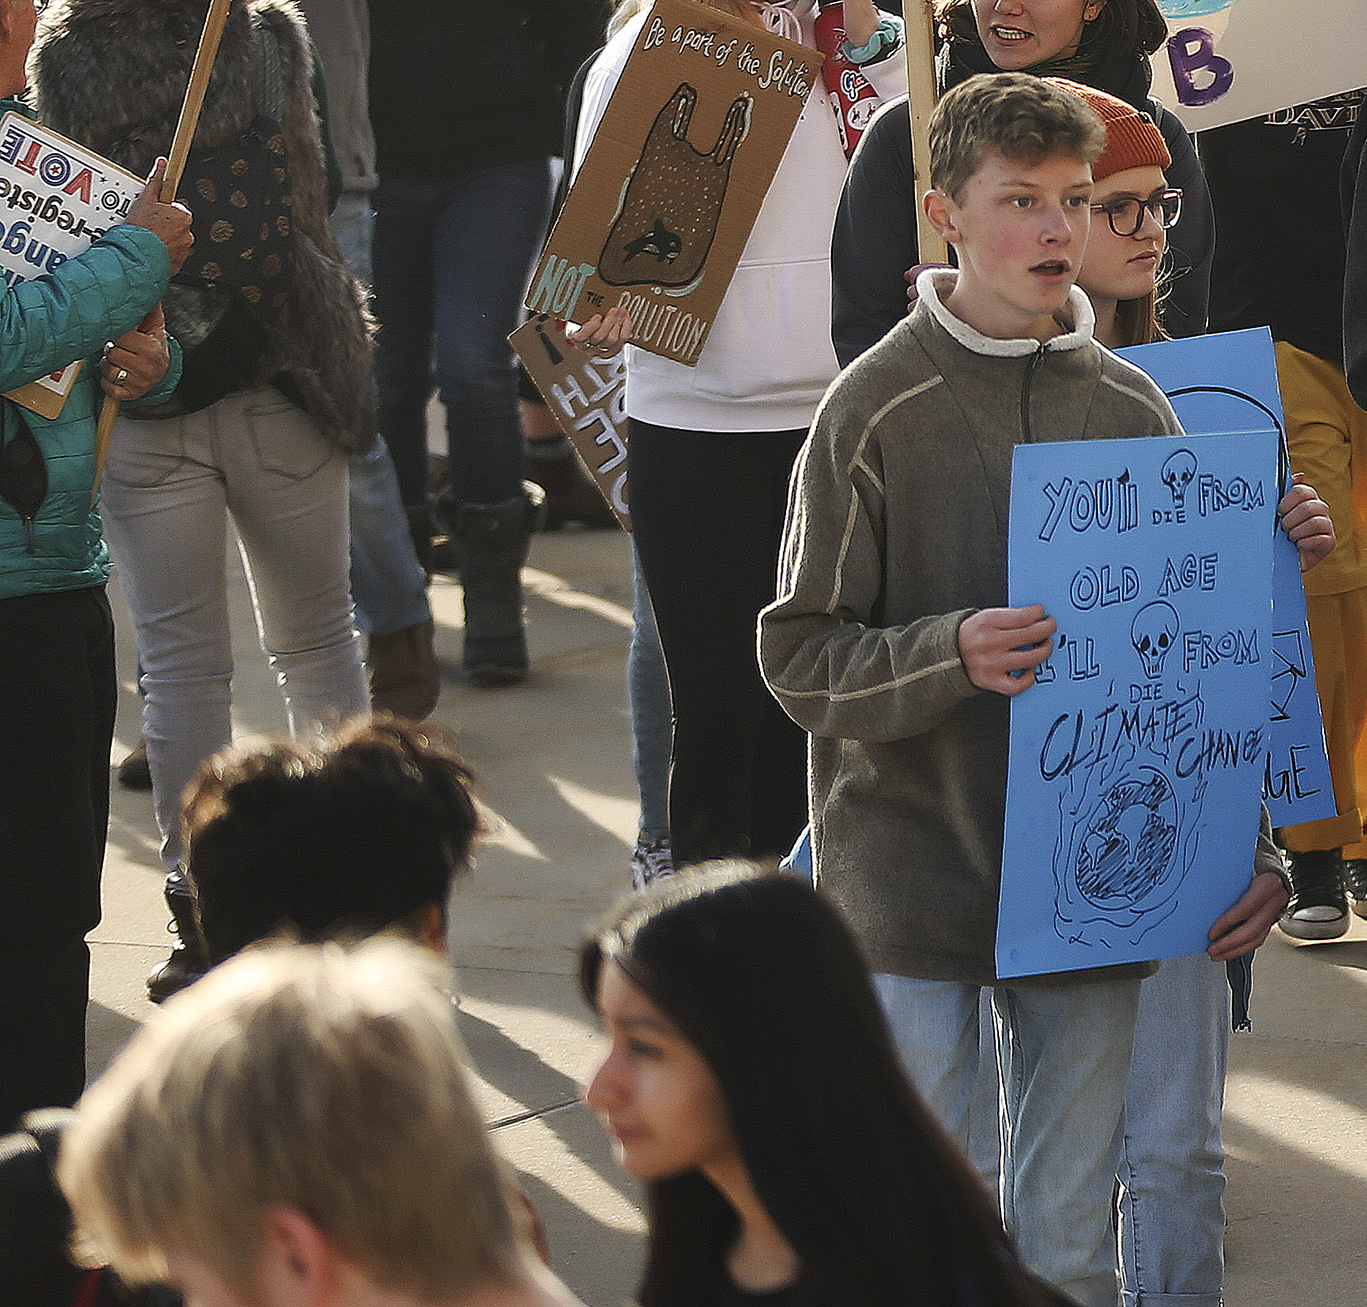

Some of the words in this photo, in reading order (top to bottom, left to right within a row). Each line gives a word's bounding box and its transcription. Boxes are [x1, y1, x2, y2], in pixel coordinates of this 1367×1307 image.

[642, 16, 665, 52] Be
[671, 27, 684, 45] a
[682, 25, 715, 61] part
[715, 37, 735, 69] of
[736, 42, 760, 76] the
[0, 128, 93, 205] VOTE
[101, 189, 132, 219] TO
[531, 254, 597, 322] NOT
[587, 290, 605, 308] THE
[1151, 508, 1188, 526] DIE
[1197, 473, 1265, 518] FROM
[1069, 565, 1140, 611] OLD
[1157, 552, 1219, 598] AGE
[1129, 683, 1165, 704] DIE
[1182, 628, 1261, 675] FROM
[1039, 697, 1198, 783] CLIMATE
[1174, 723, 1266, 781] CHANGE
